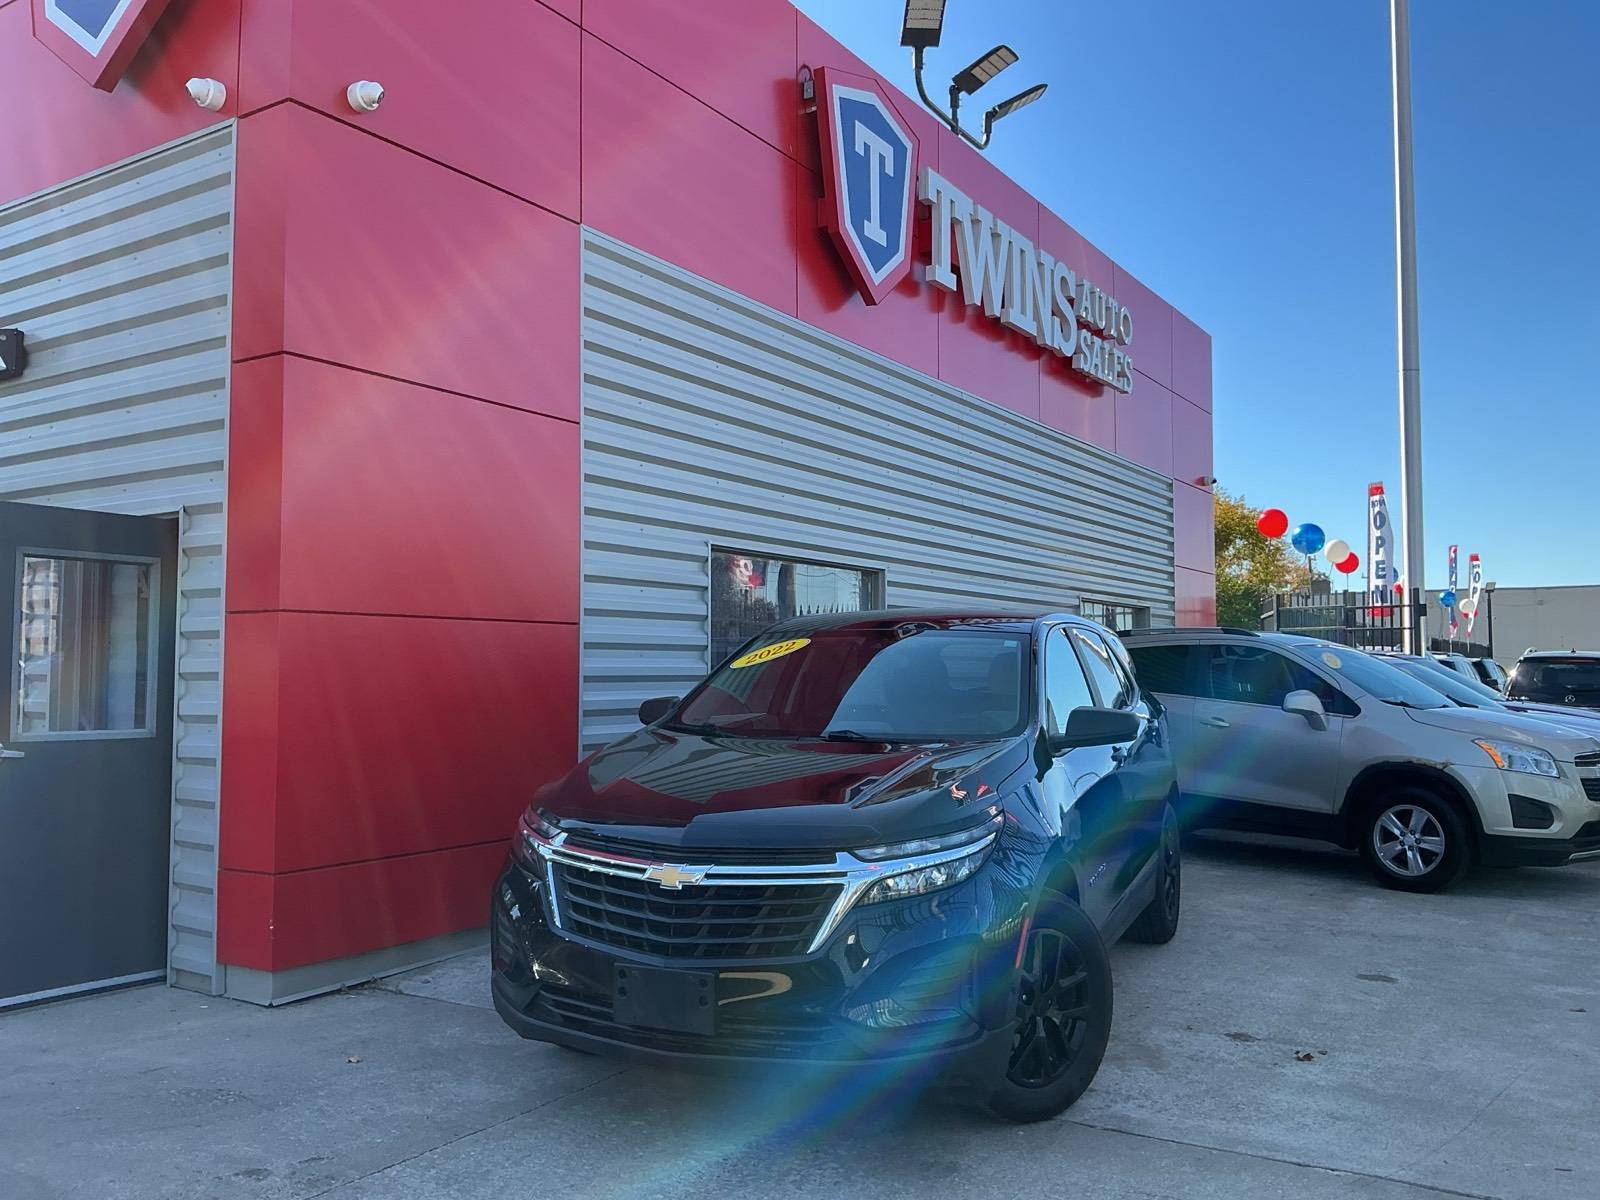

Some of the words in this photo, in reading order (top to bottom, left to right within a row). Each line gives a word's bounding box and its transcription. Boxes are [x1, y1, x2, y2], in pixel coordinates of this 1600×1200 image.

[855, 119, 894, 248] T
[919, 166, 1078, 358] TWINS
[1077, 279, 1133, 346] AUTO
[1074, 329, 1133, 394] SALES
[1373, 510, 1388, 604] OPEN
[745, 641, 797, 665] 2022
